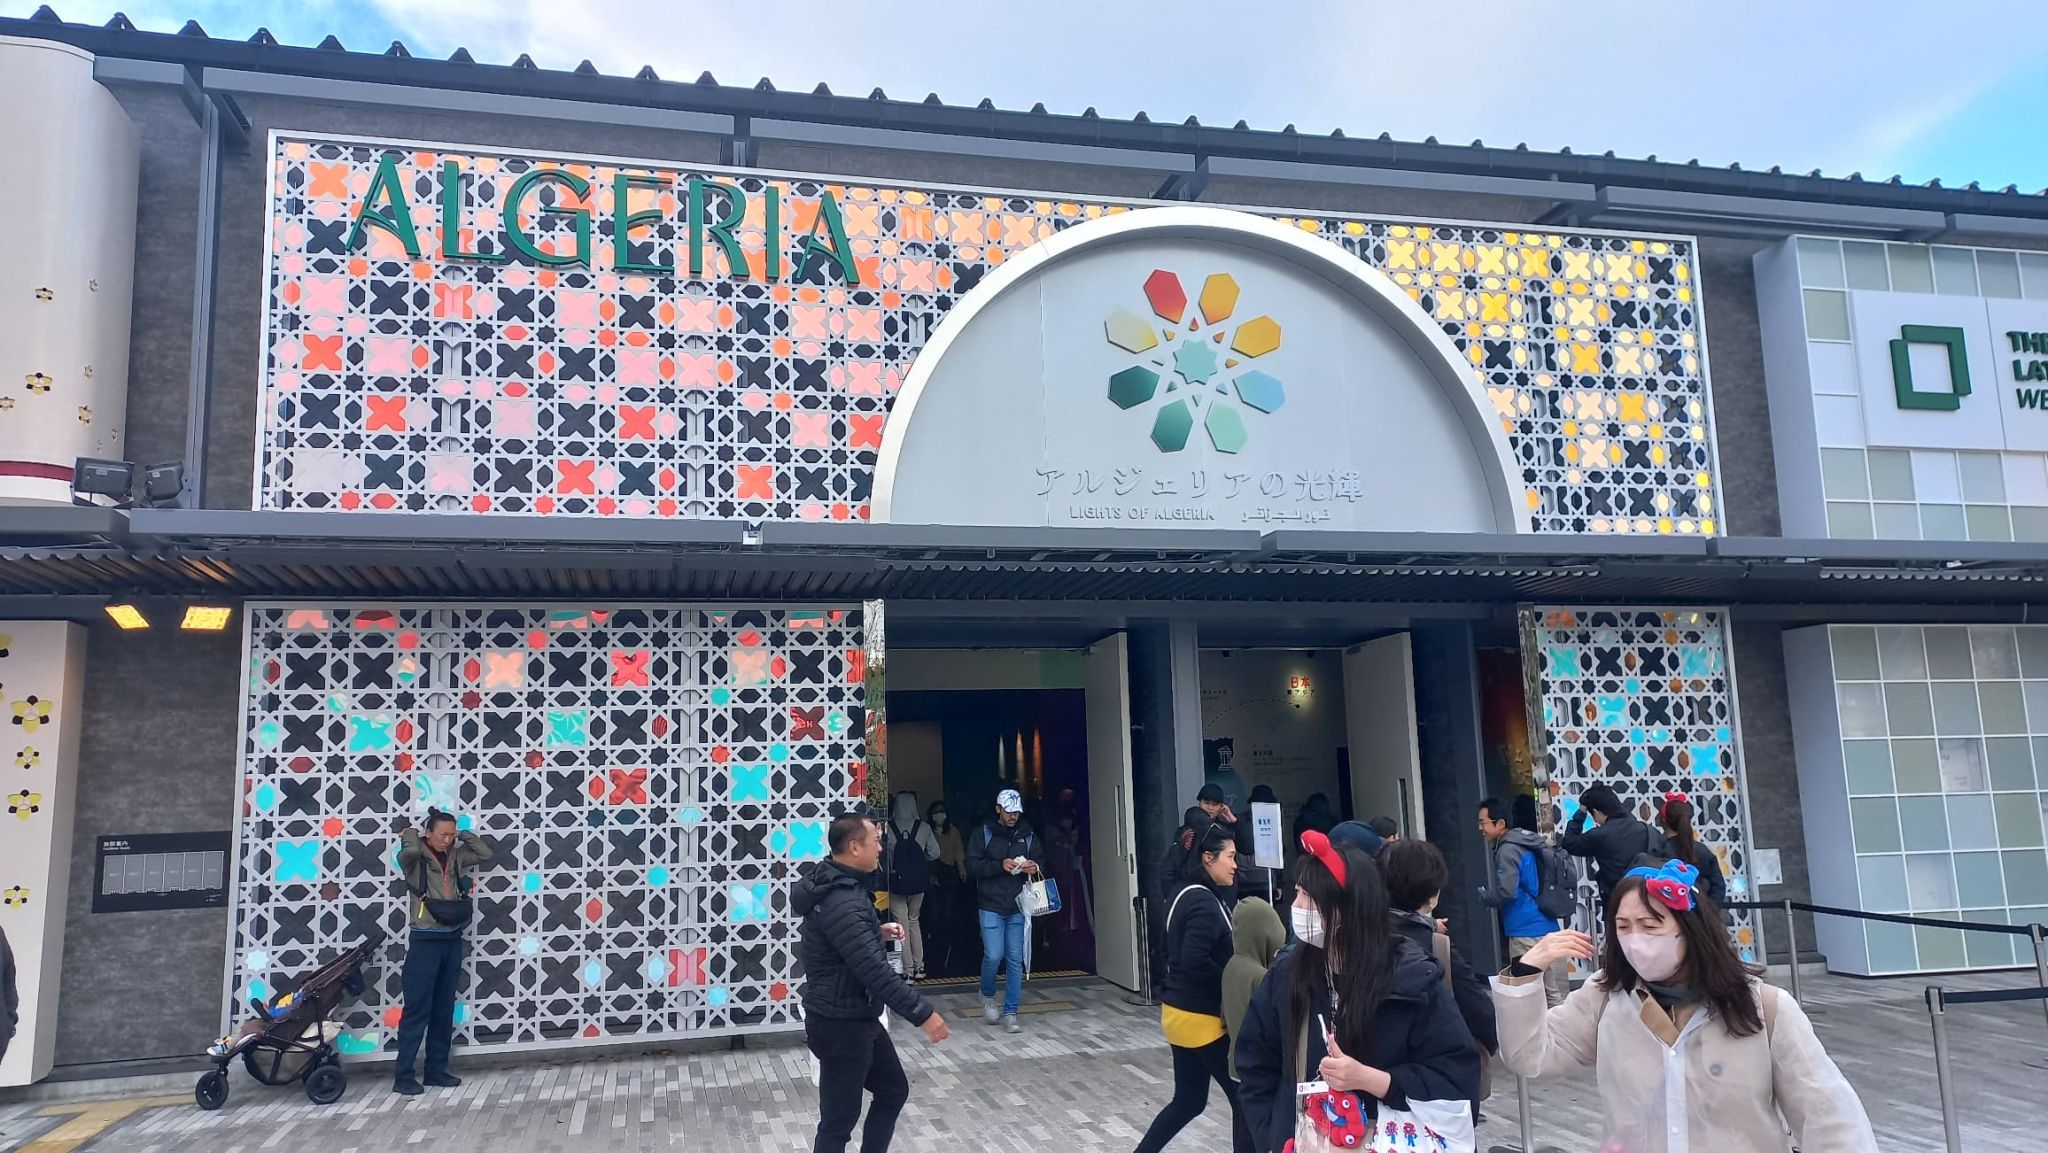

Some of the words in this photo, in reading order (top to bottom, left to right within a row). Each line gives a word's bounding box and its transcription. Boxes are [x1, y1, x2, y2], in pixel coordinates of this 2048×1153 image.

[345, 156, 859, 284] ALGERIA
[1036, 466, 1364, 503] アルジェリアの光輝
[1069, 506, 1121, 520] LIGHTS
[1128, 507, 1148, 520] OF
[1155, 507, 1215, 521] ALGERIA
